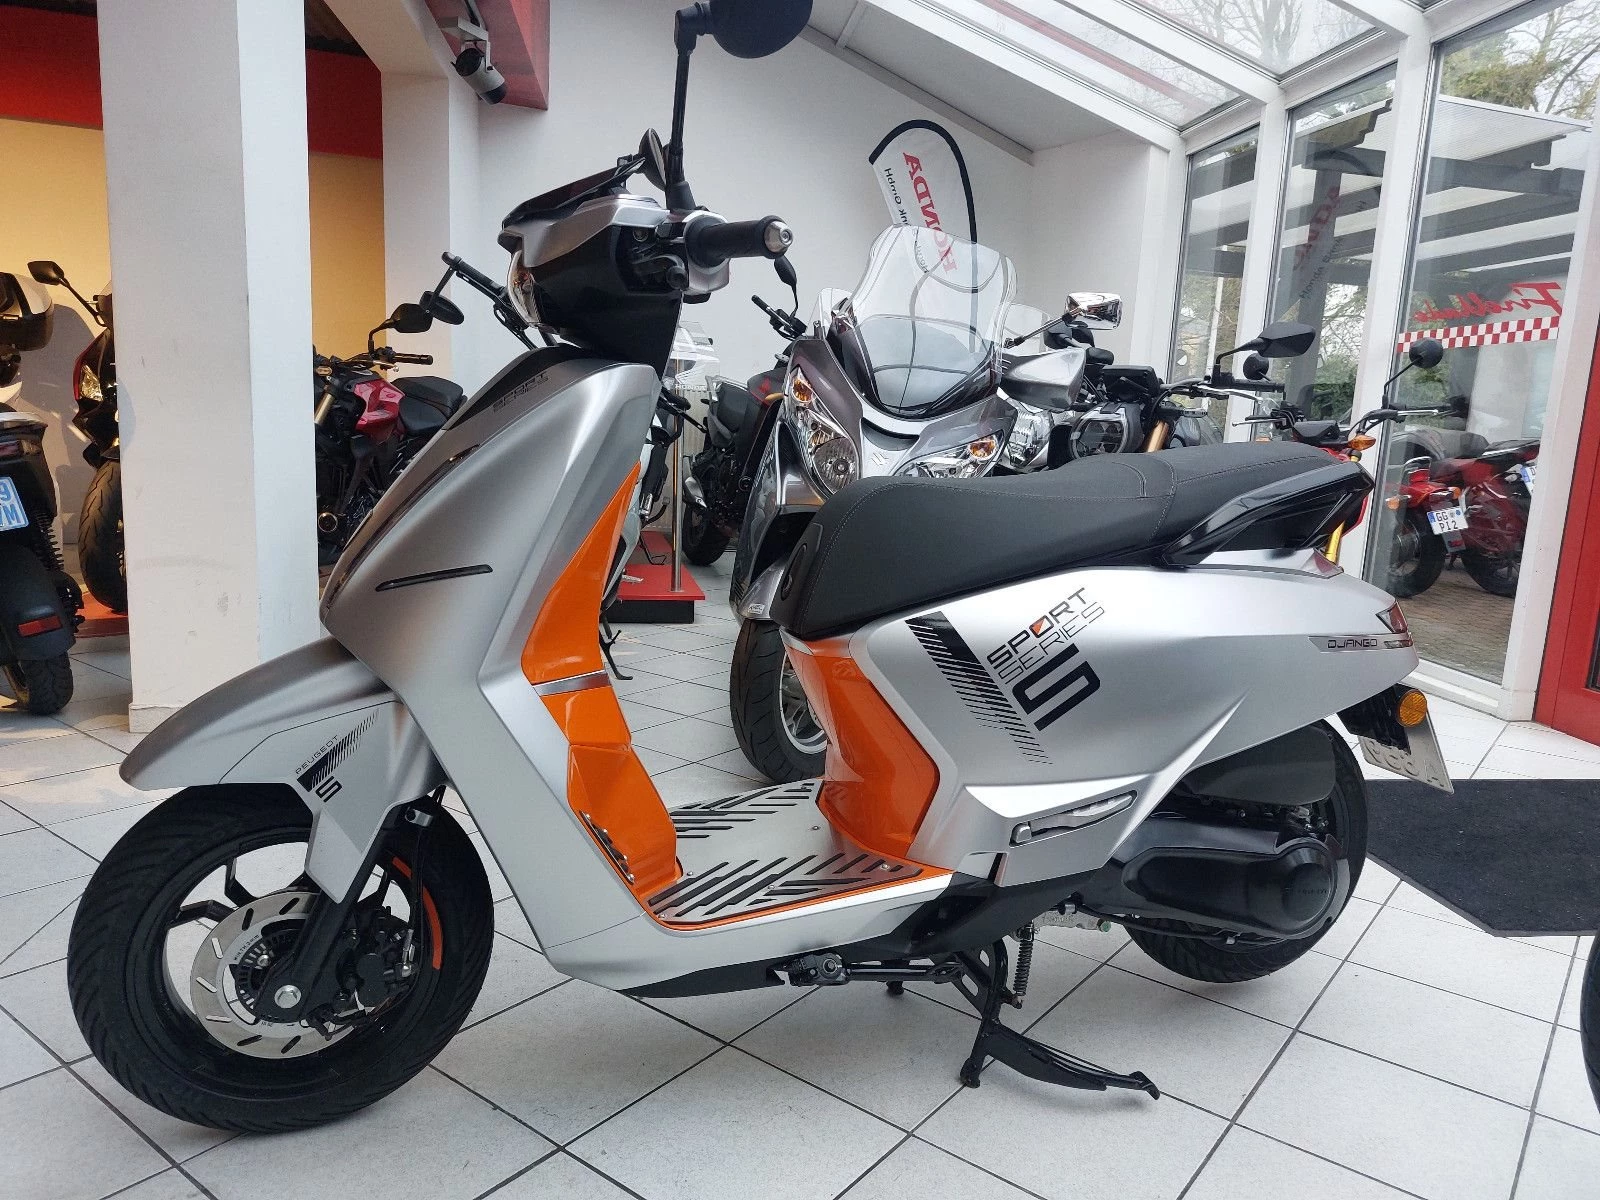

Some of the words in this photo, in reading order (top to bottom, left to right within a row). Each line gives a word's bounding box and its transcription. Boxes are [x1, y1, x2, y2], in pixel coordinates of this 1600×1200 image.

[1436, 511, 1448, 521] GG
[986, 587, 1086, 670] SPORT
[997, 601, 1105, 685] SERIES
[1327, 638, 1378, 649] DJANGO
[1012, 642, 1101, 731] S
[295, 734, 339, 775] PEUGEOT
